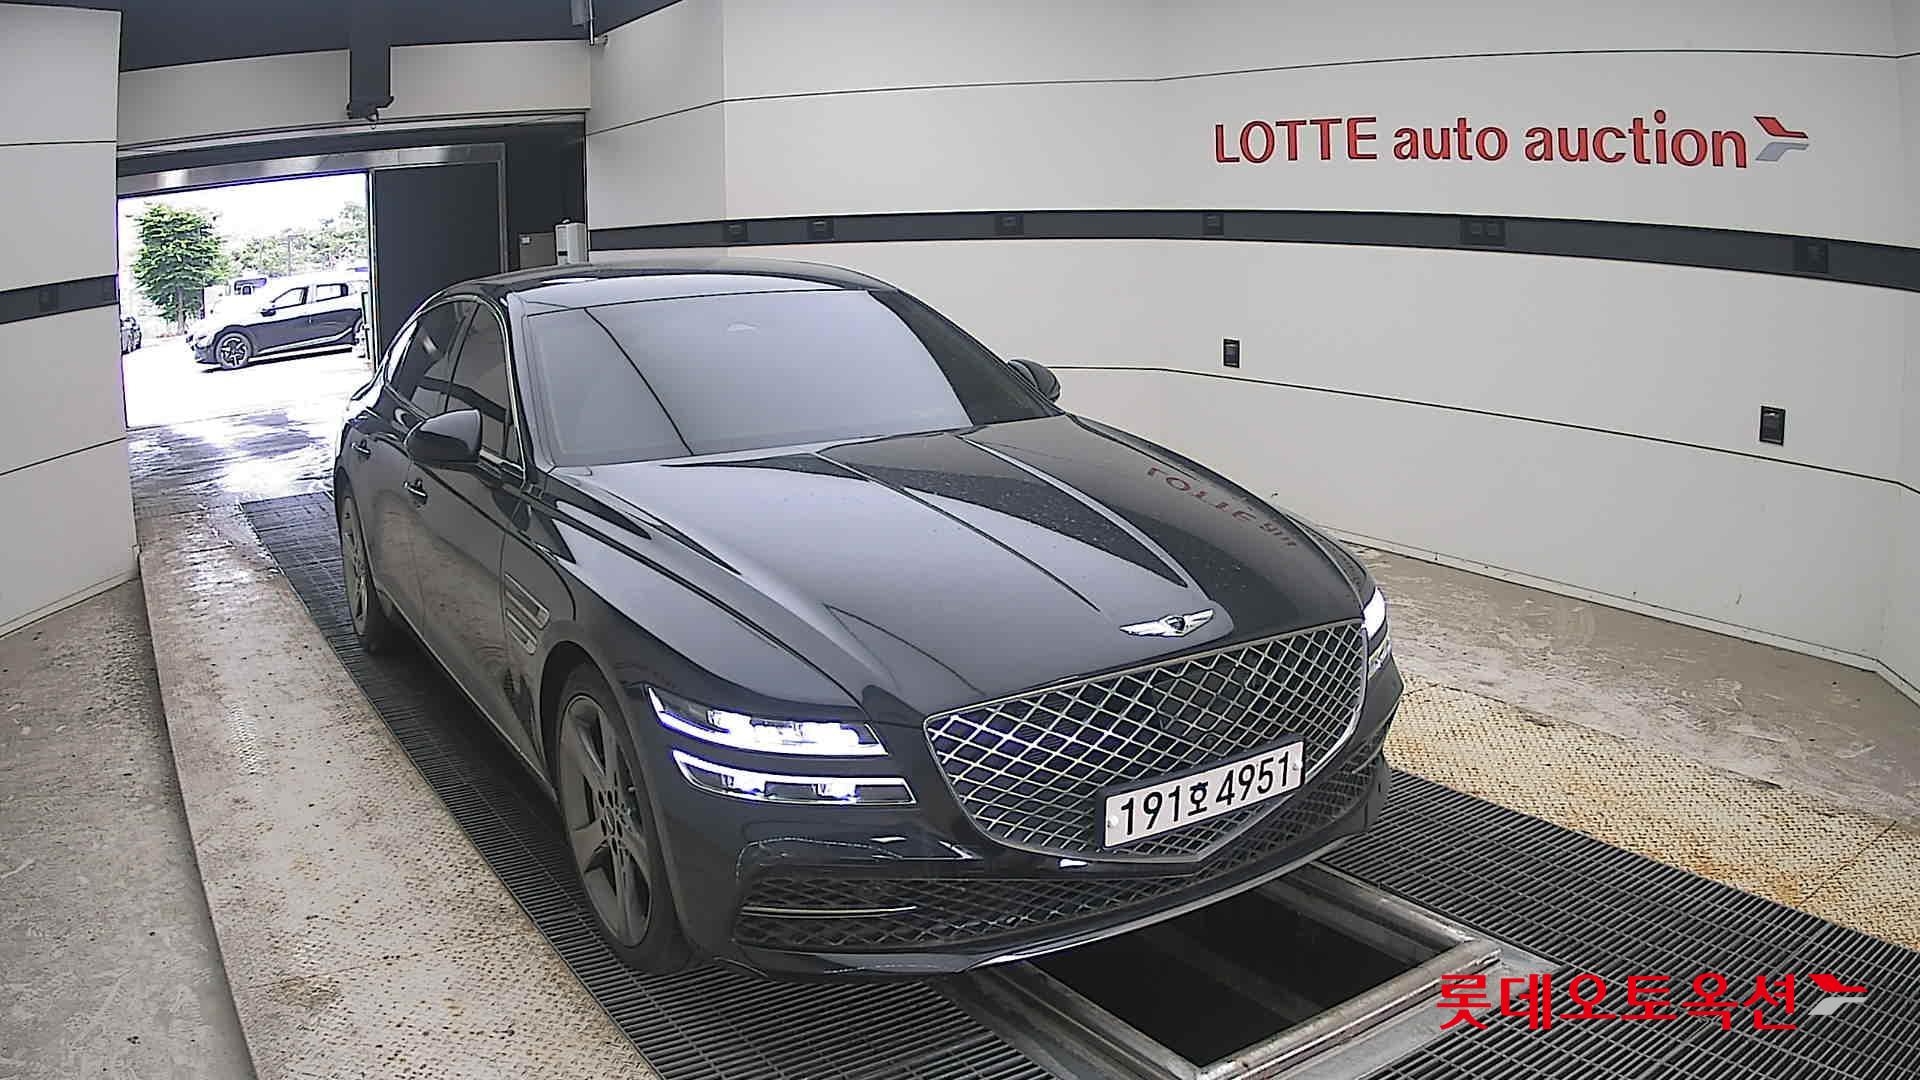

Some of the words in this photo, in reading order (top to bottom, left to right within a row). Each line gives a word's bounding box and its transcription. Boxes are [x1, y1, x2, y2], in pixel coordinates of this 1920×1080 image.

[1214, 116, 1378, 164] LOTTE
[1392, 116, 1508, 162] auto
[1523, 109, 1747, 169] auction
[1120, 780, 1209, 836] 191호
[1215, 751, 1290, 806] 4951
